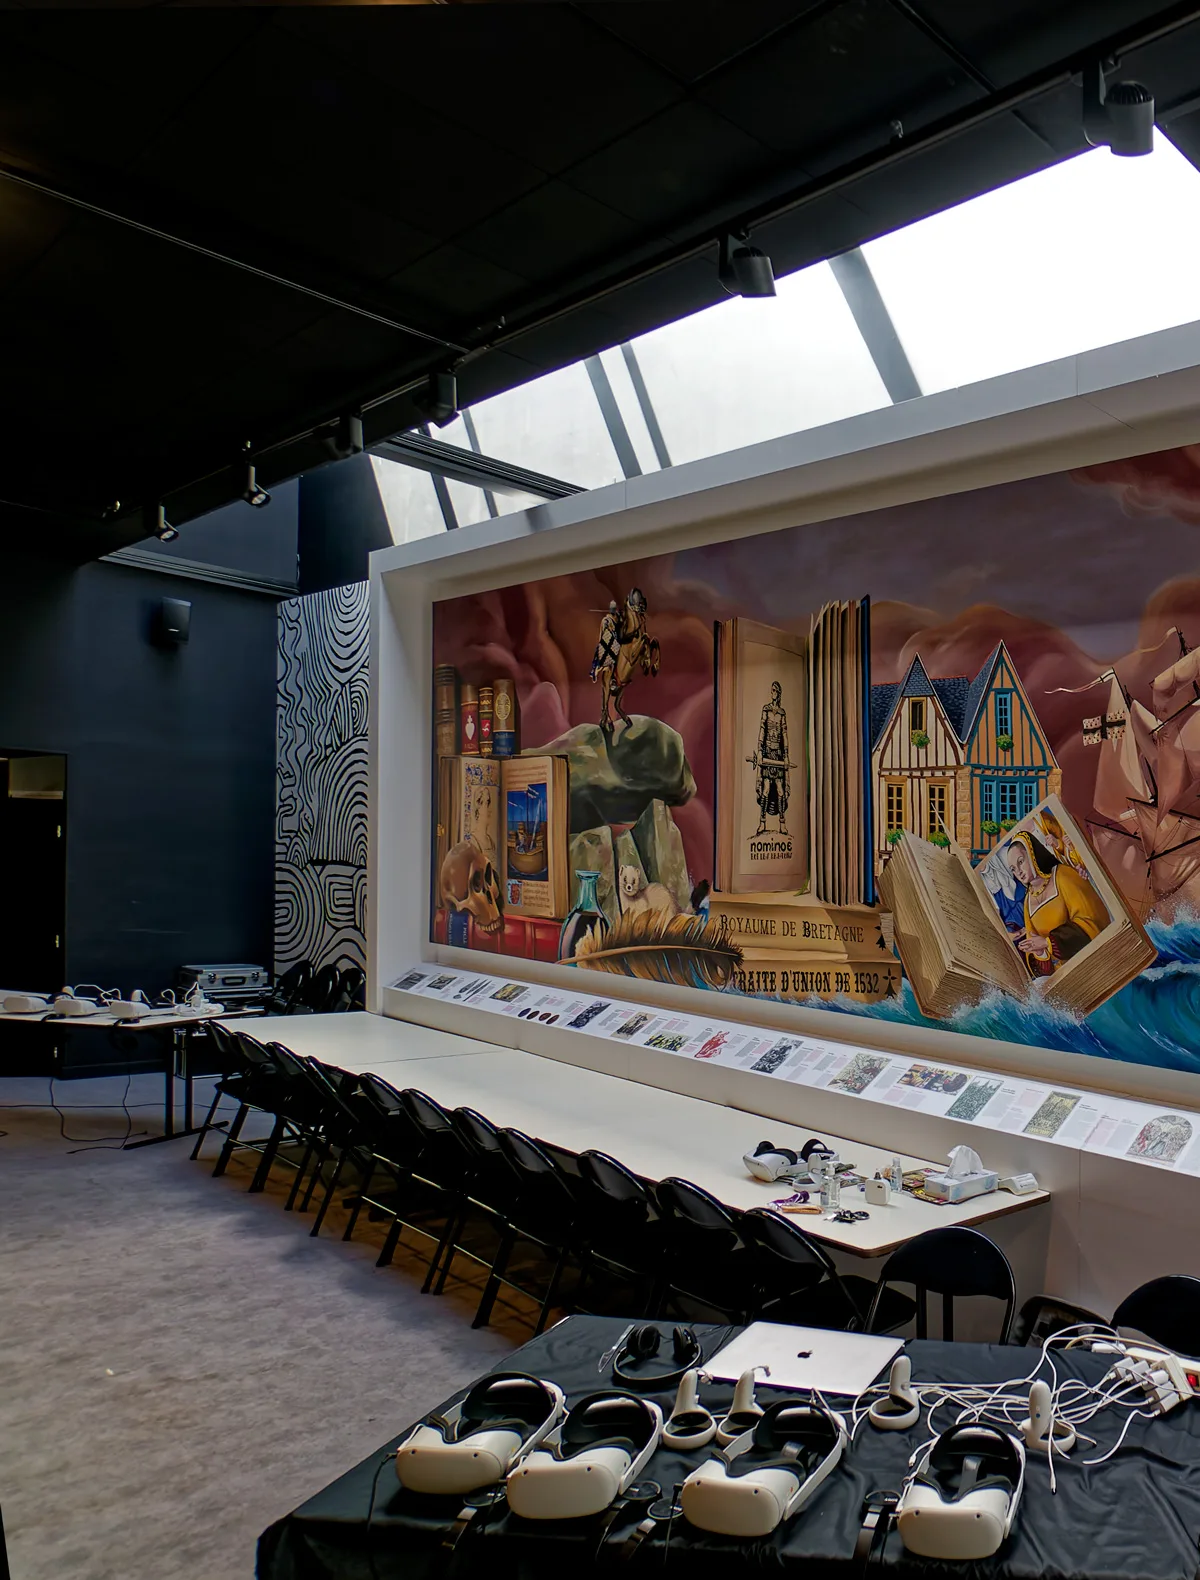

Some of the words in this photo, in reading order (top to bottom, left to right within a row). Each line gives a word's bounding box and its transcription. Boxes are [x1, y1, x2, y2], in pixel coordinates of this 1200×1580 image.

[719, 914, 777, 936] ROYAUME
[782, 920, 797, 937] DE
[802, 920, 865, 943] BRETAGNE
[781, 969, 831, 993] D'UNION
[835, 972, 851, 992] DE
[854, 972, 880, 994] 1532
